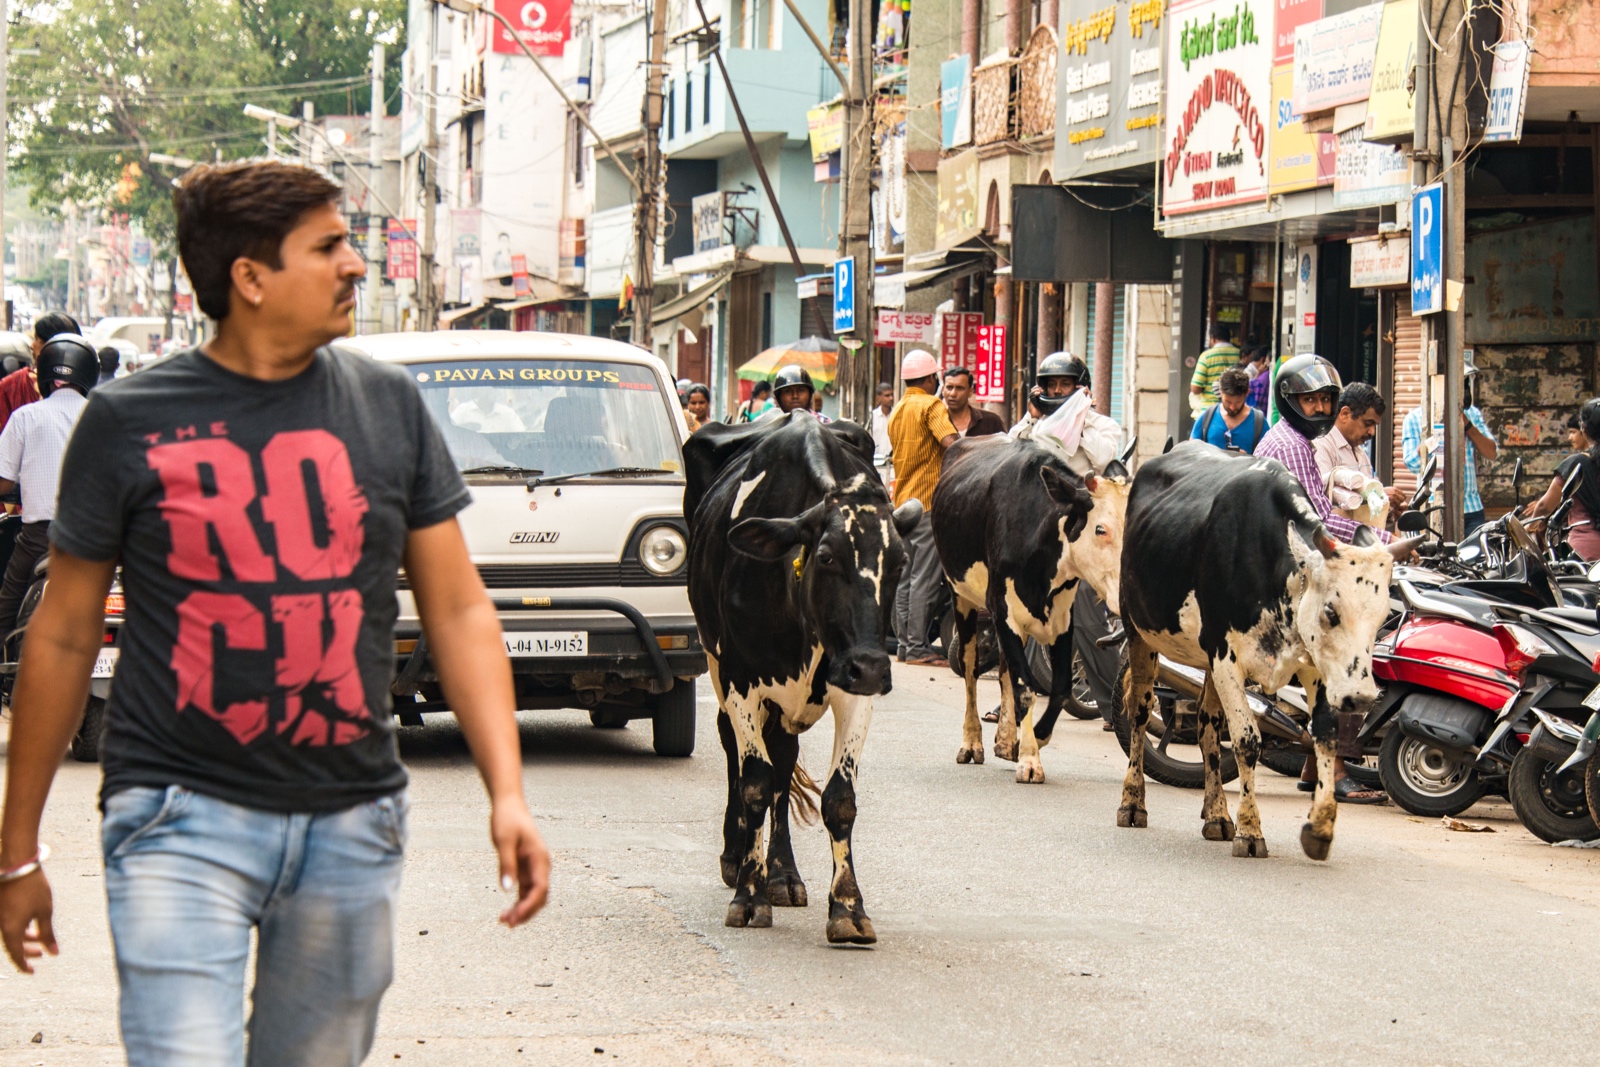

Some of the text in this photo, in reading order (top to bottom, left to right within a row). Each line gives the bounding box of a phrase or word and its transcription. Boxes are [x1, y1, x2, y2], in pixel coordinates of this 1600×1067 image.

[1215, 69, 1251, 128] WATCH
[1420, 196, 1433, 260] P
[838, 264, 848, 301] P
[993, 328, 1004, 387] WEDDING
[434, 367, 654, 391] PAVAN GROUPS PRESS
[144, 422, 229, 446] THE
[510, 532, 561, 544] OMNI
[535, 638, 583, 653] M-9152
